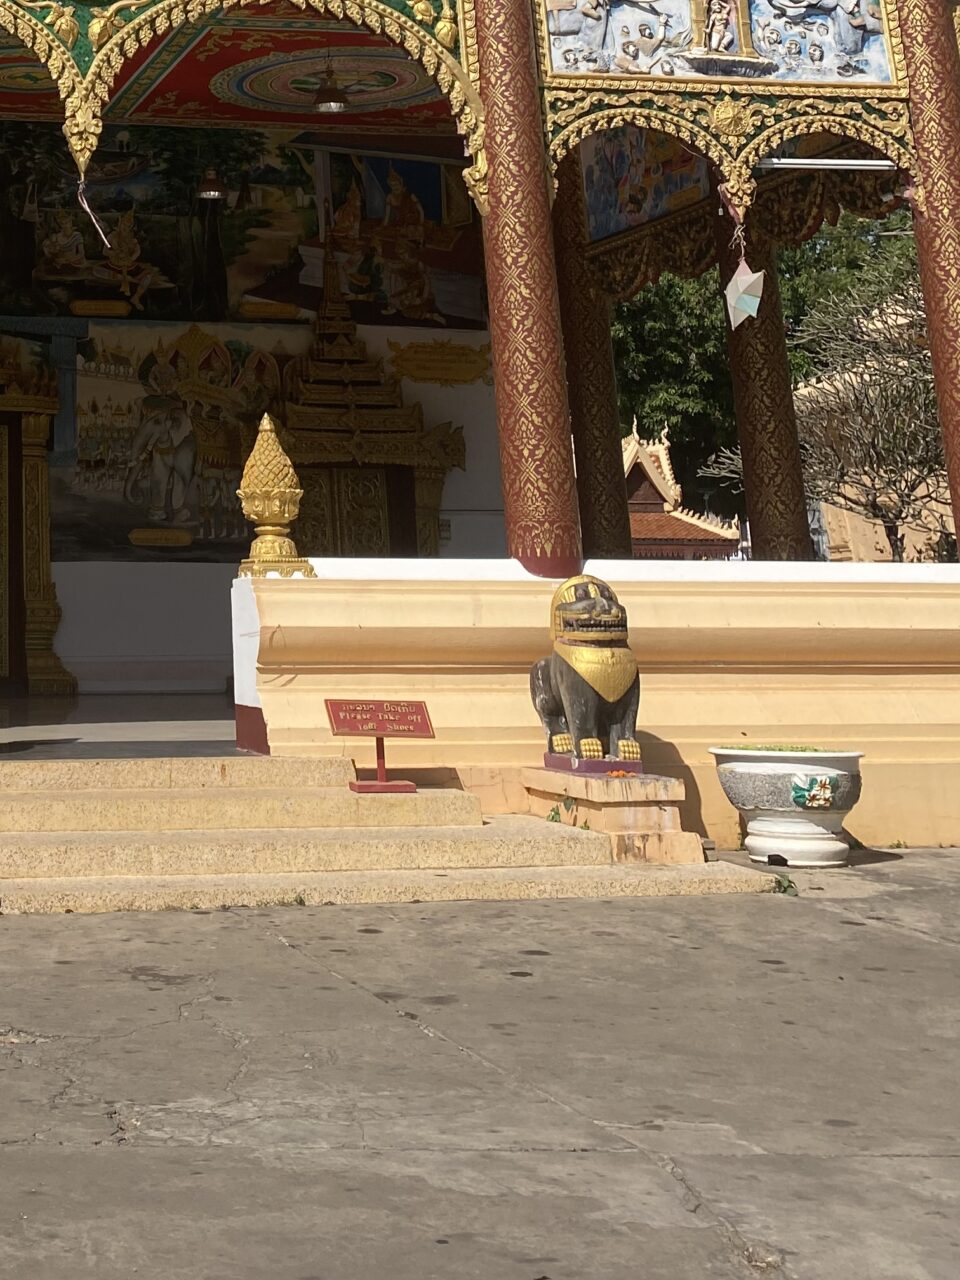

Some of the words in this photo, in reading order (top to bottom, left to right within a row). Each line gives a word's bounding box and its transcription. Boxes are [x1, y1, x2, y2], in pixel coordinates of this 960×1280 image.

[339, 711, 372, 720] Please
[377, 712, 401, 720] Take
[407, 714, 422, 723] off
[386, 722, 415, 731] Shoes
